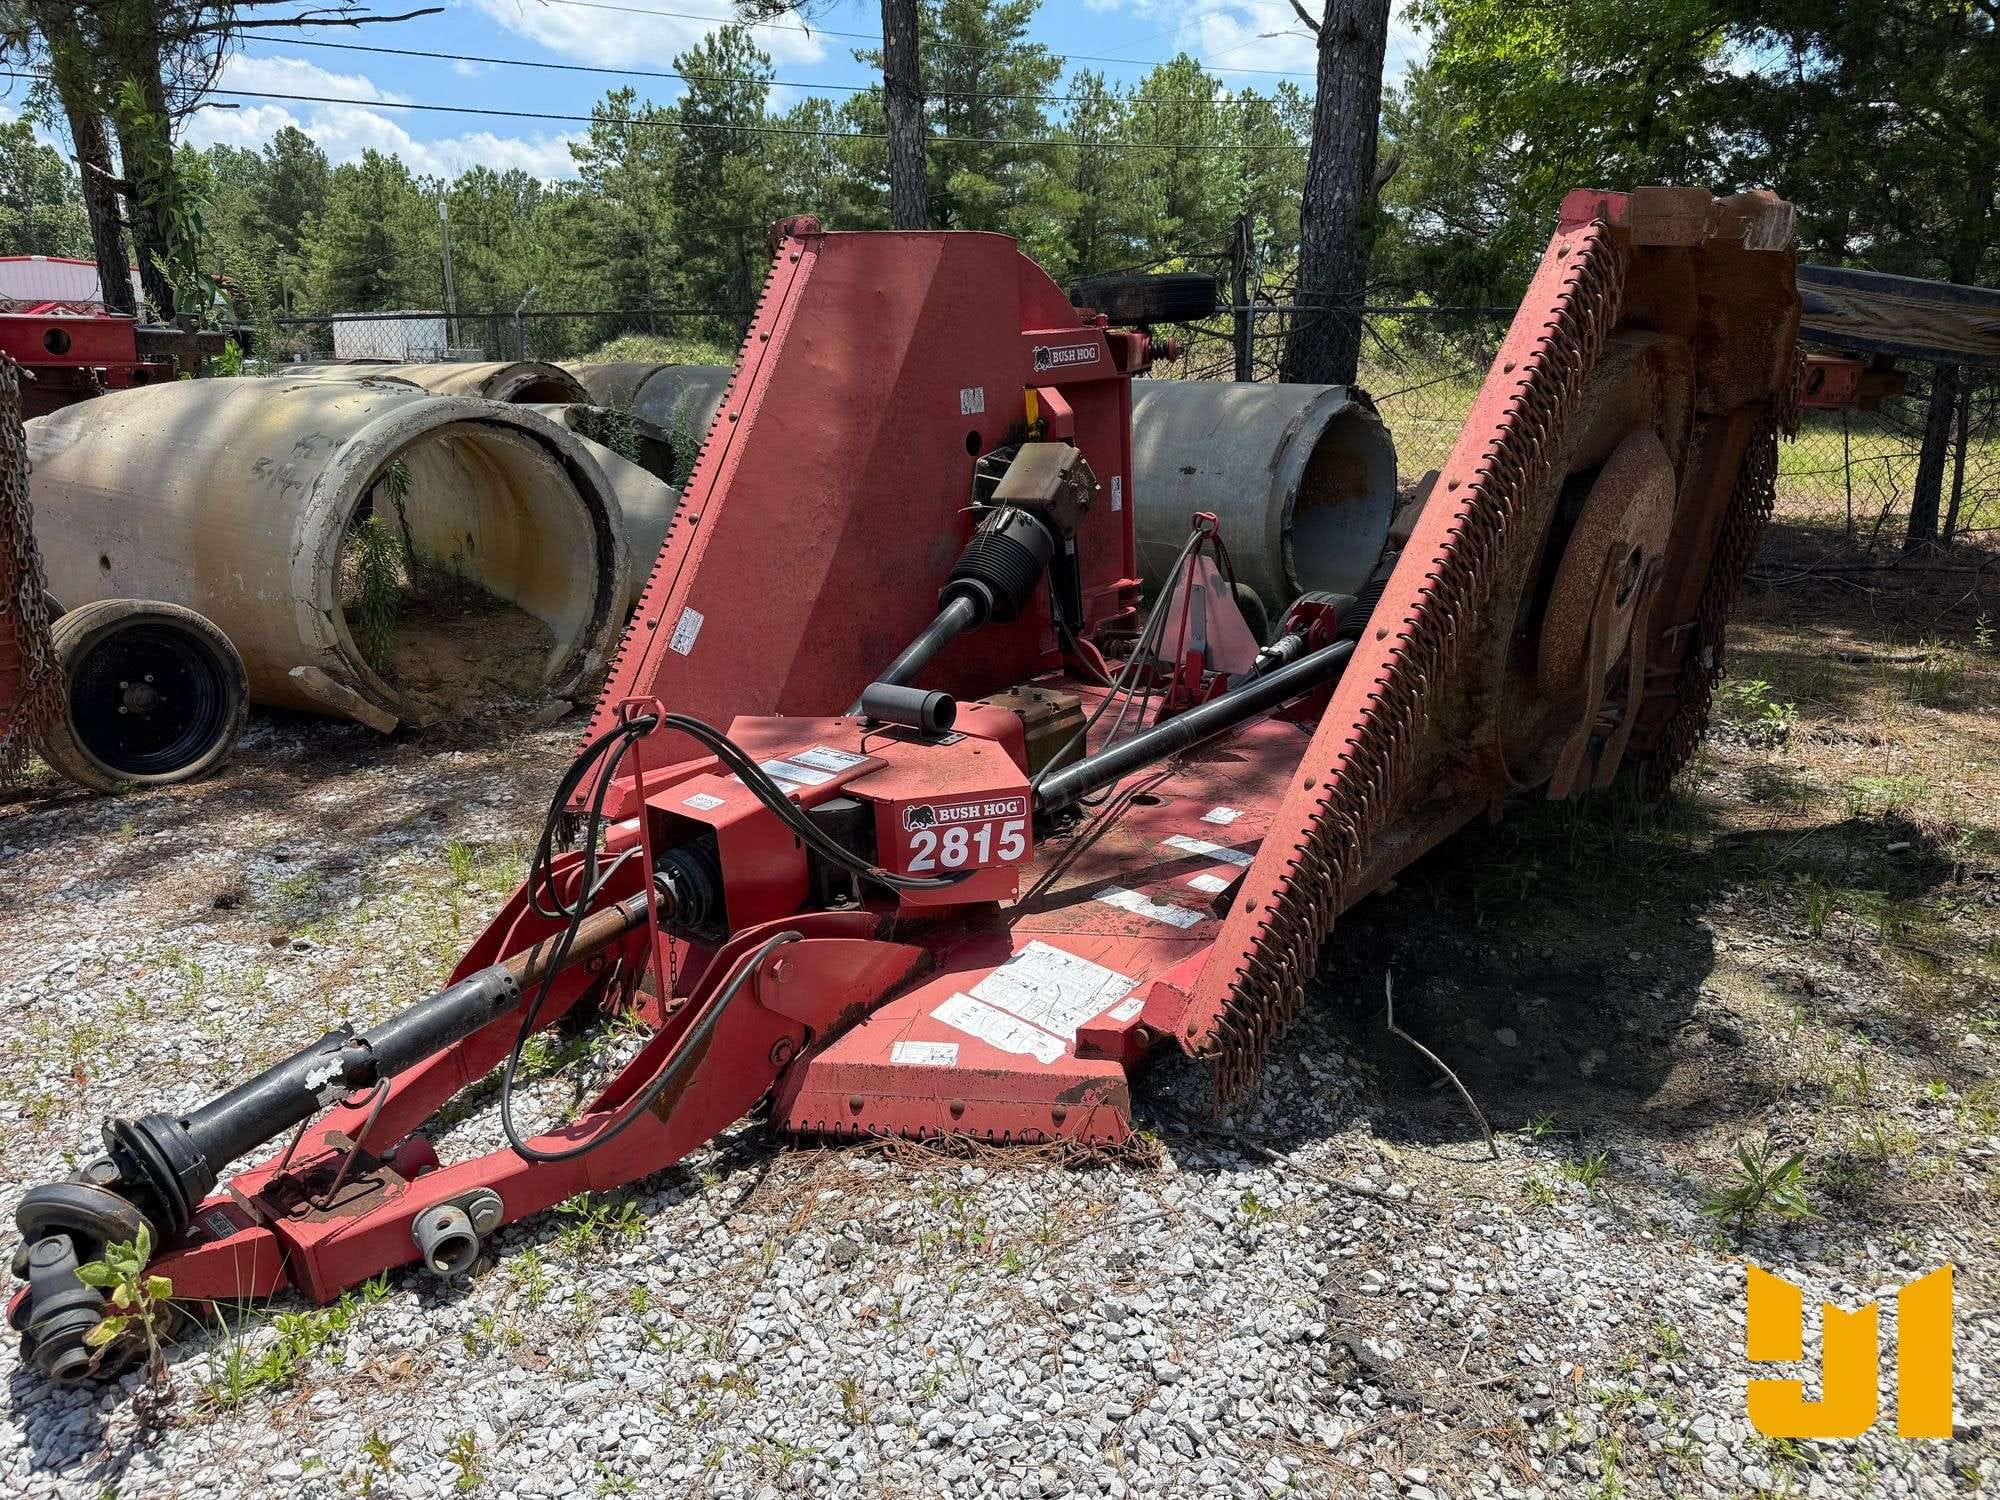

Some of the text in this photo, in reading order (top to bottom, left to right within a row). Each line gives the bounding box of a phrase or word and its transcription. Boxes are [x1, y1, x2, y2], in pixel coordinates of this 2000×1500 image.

[1052, 347, 1095, 362] BUSH HOG
[939, 801, 1018, 821] BUSH HOG
[907, 819, 1026, 872] 2815
